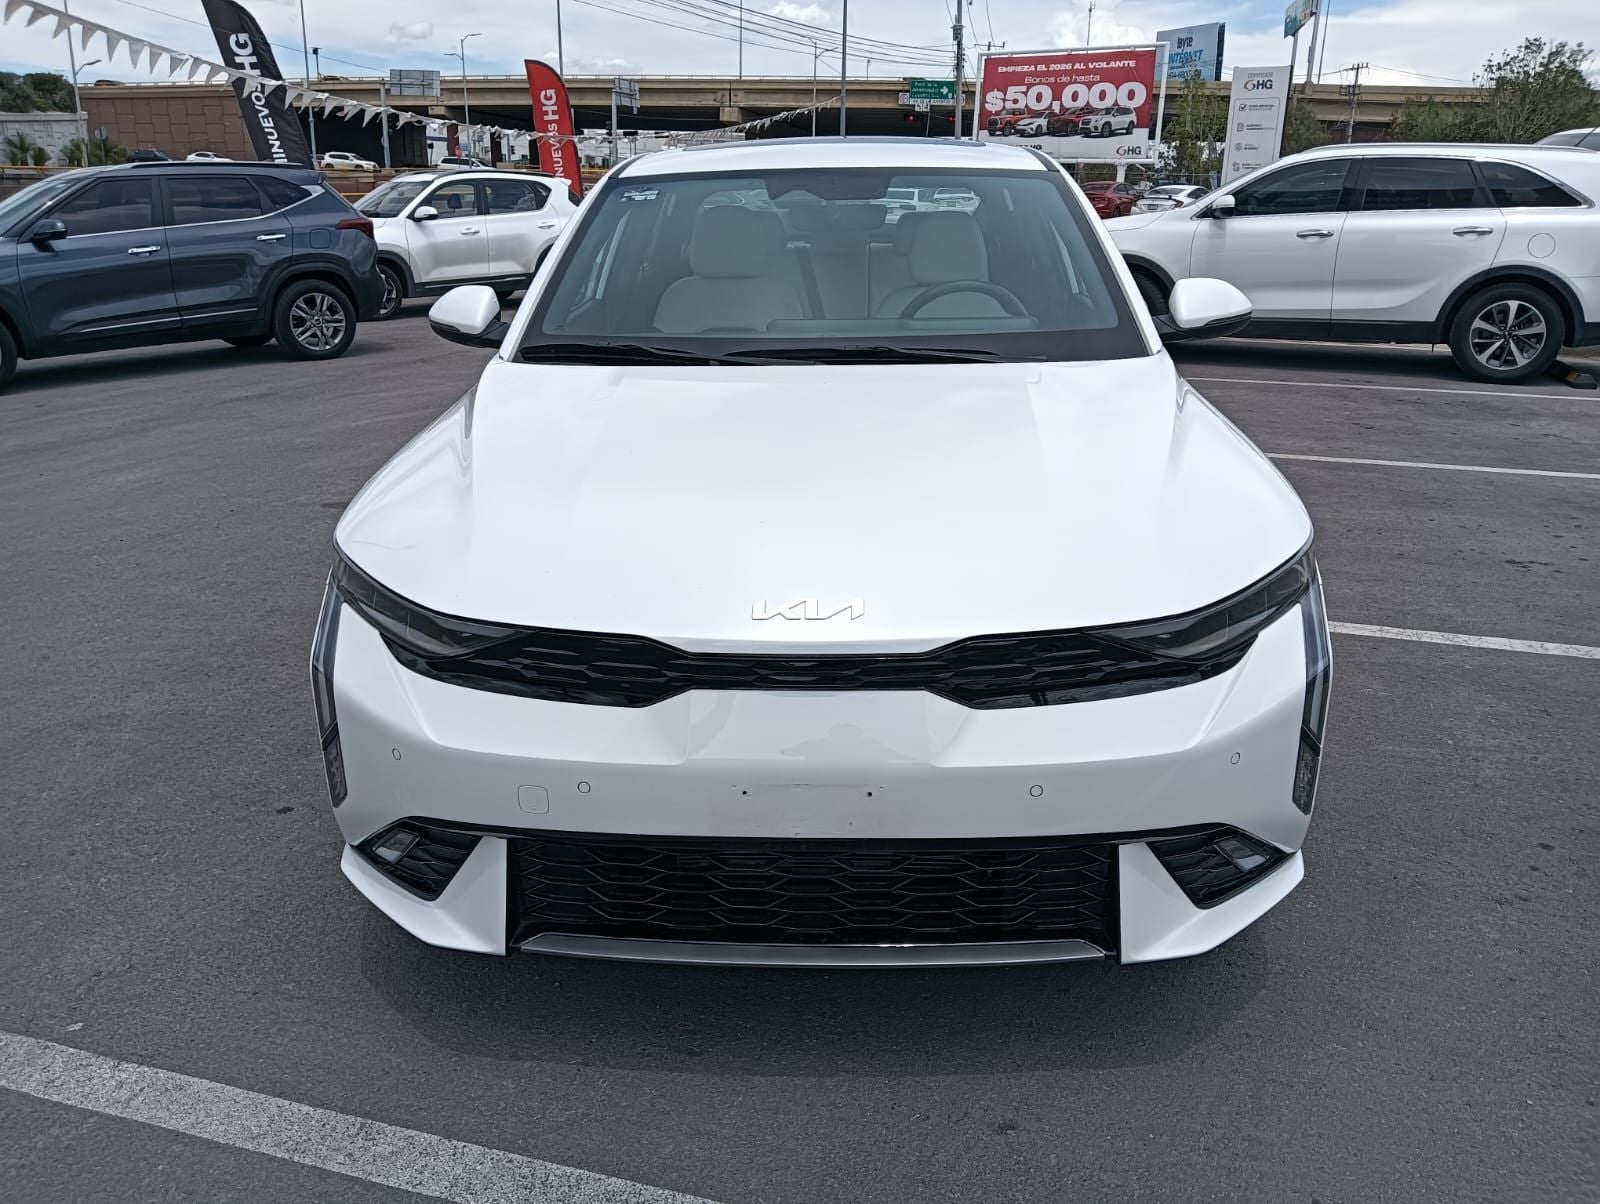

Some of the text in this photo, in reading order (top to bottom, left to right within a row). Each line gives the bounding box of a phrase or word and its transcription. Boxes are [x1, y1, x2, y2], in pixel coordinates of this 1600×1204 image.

[229, 32, 262, 76] HG
[1073, 62, 1086, 70] AL
[1088, 60, 1136, 69] VOLANTE
[1024, 74, 1100, 84] Bonos de hasta
[540, 89, 559, 120] HG
[985, 81, 1147, 113] $50,000
[752, 598, 865, 621] KIA
